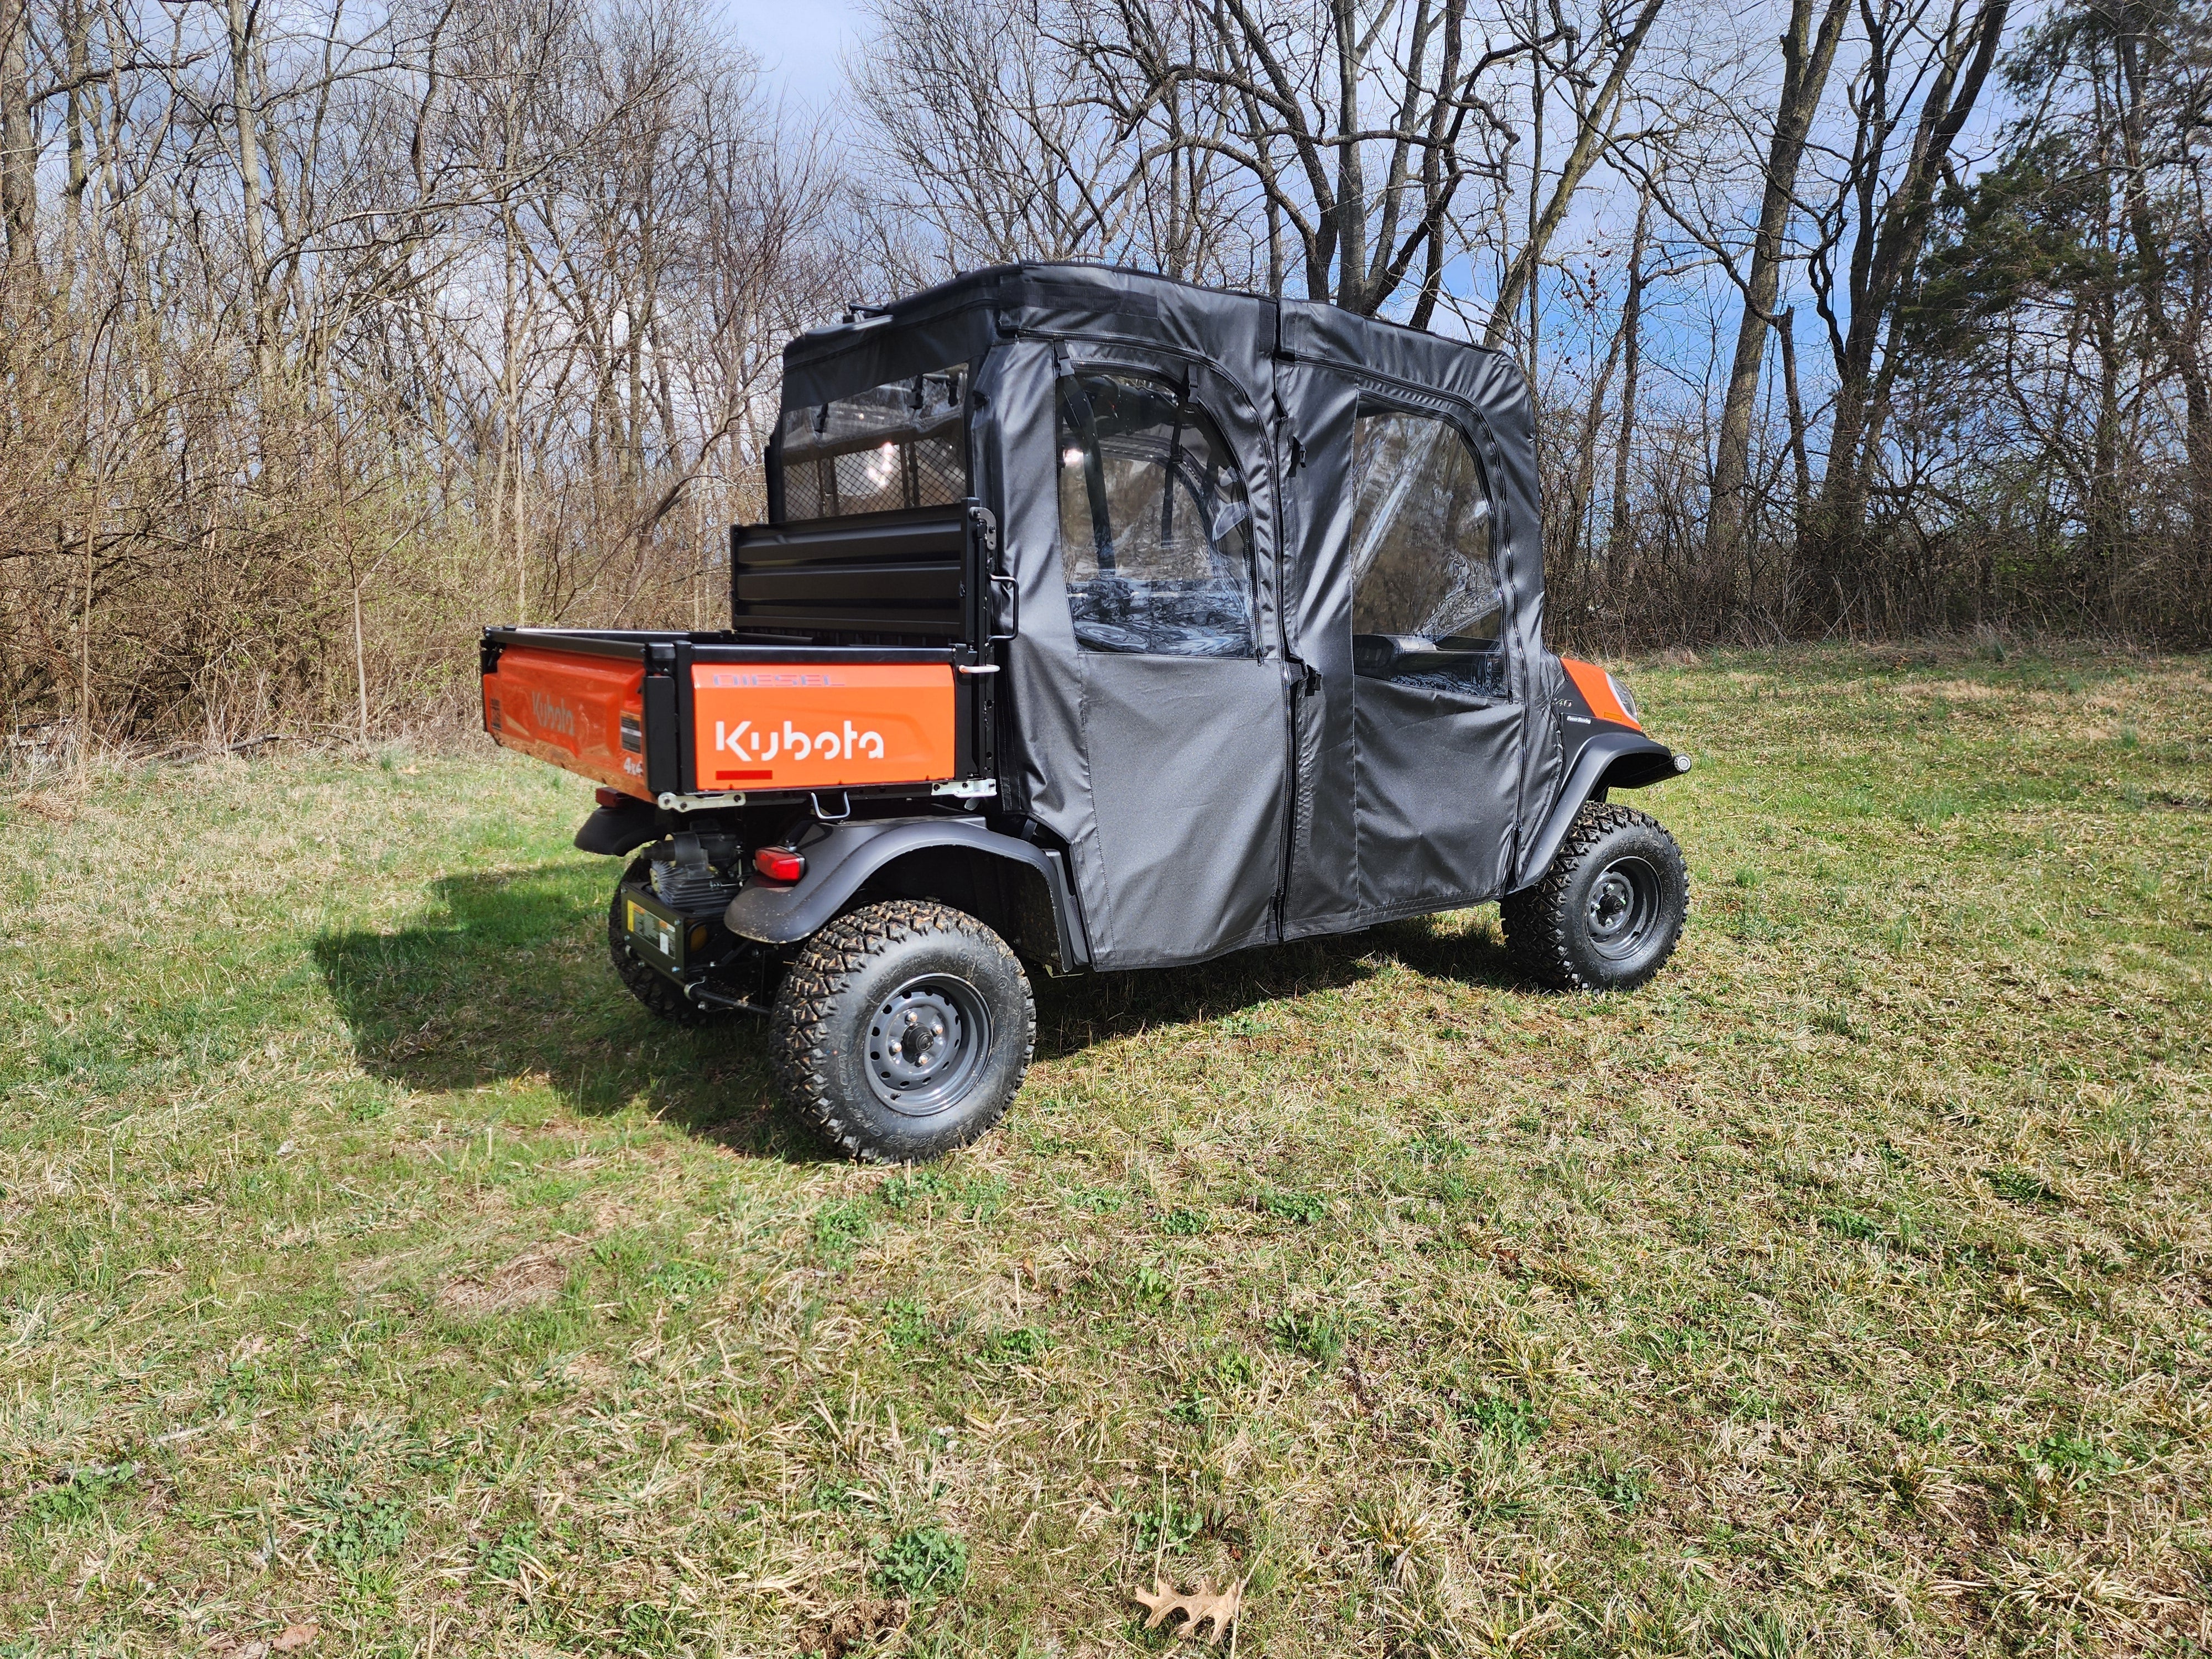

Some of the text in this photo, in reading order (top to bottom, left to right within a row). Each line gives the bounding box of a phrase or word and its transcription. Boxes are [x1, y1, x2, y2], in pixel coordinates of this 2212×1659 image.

[713, 674, 845, 686] DIESEL
[531, 690, 575, 736] Kubota
[716, 720, 884, 761] Kubota
[838, 1034, 854, 1101] ROAD
